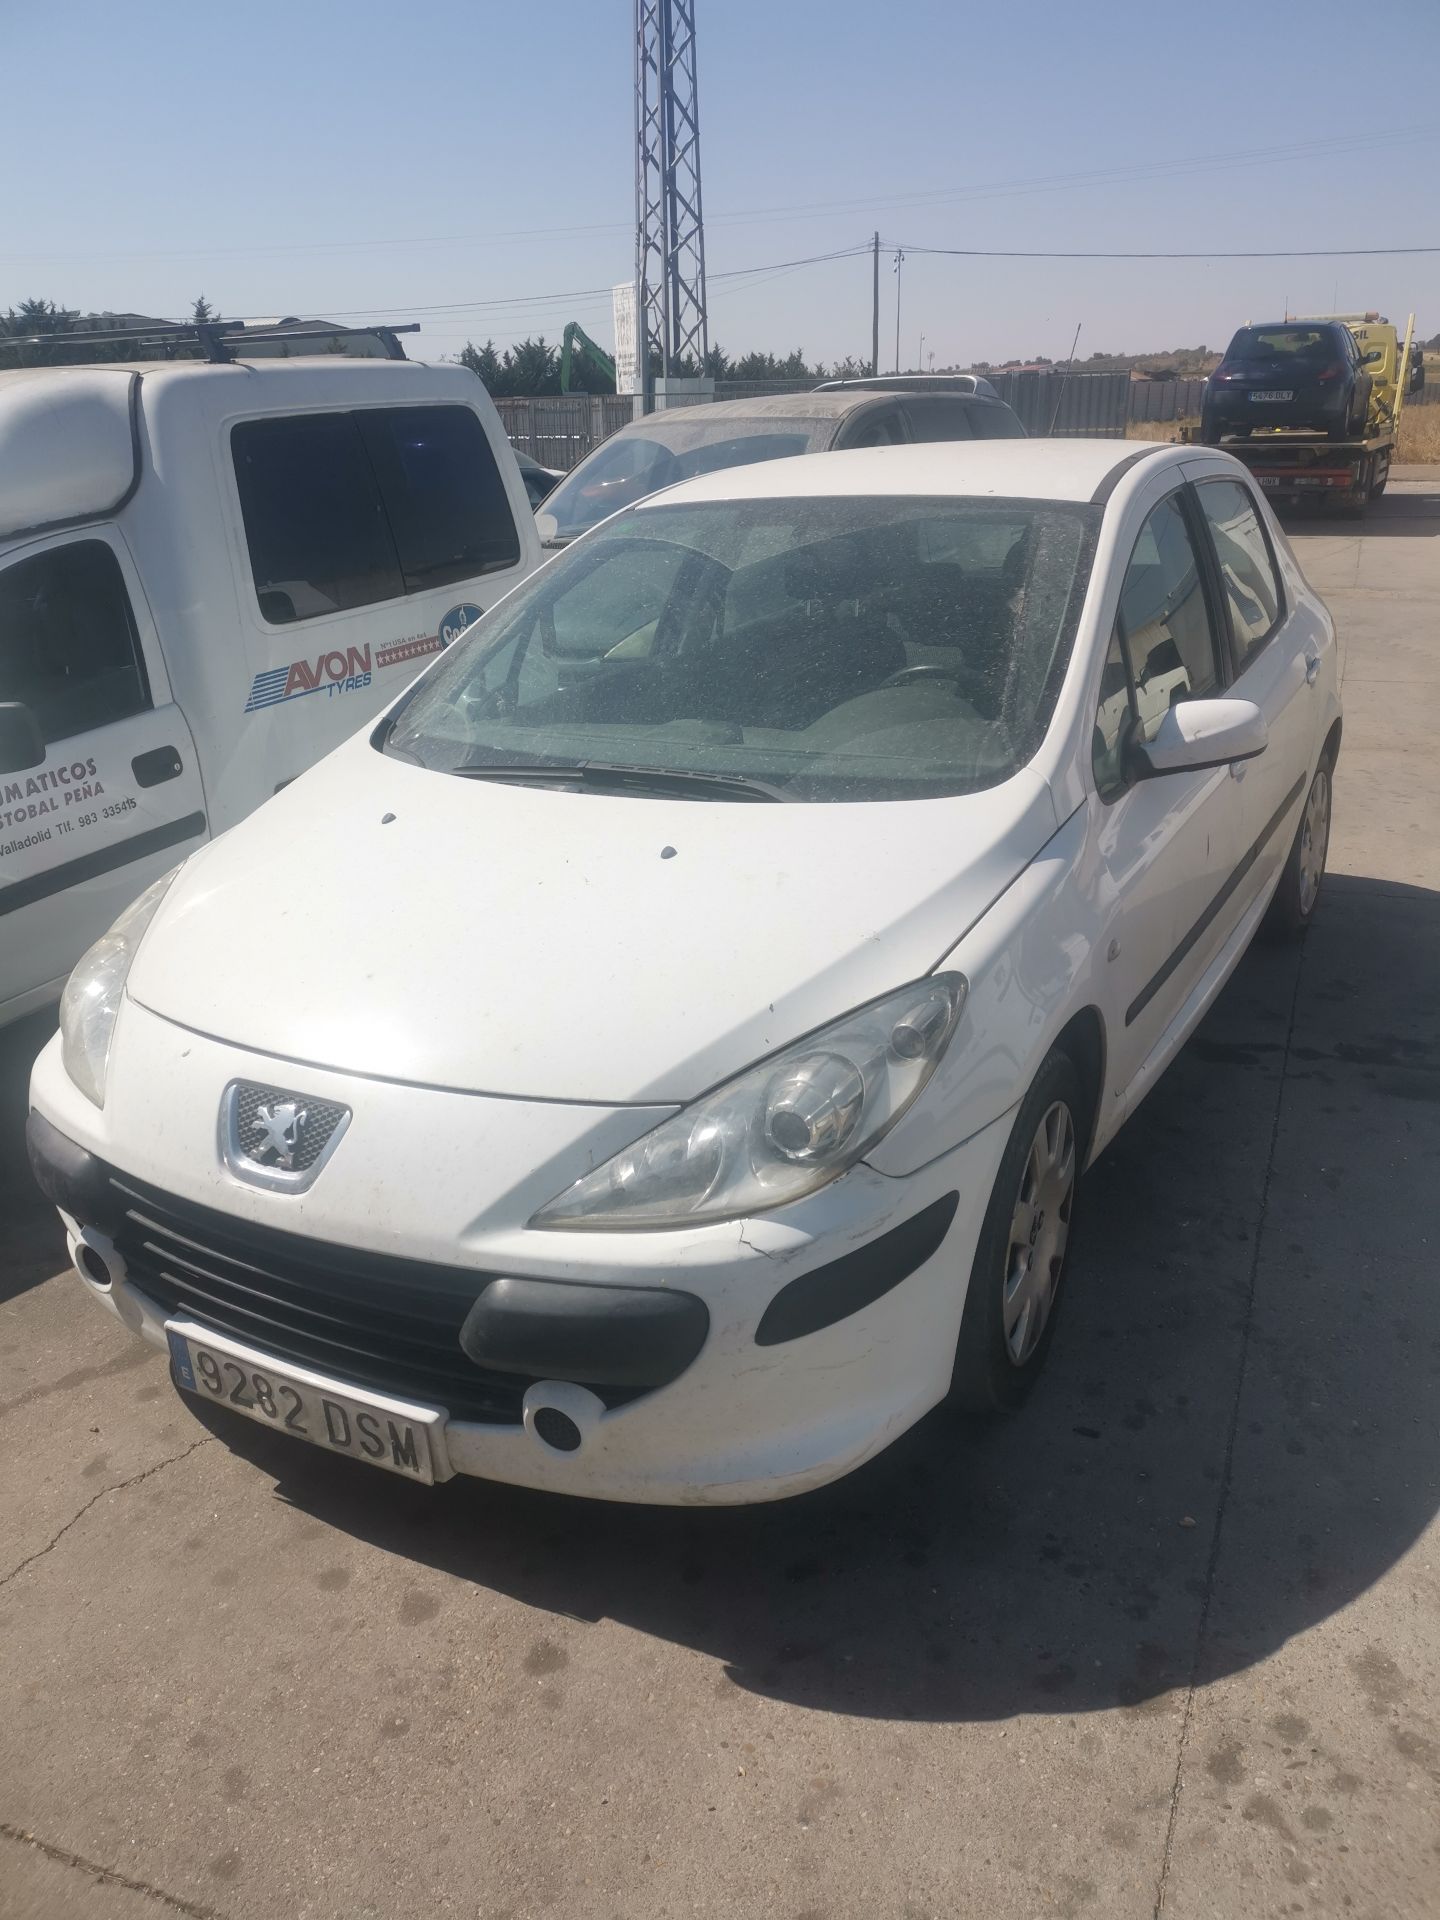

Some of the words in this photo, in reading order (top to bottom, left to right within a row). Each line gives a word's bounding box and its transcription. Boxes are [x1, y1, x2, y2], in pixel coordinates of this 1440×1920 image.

[392, 637, 406, 647] USA
[283, 642, 372, 697] AVON
[327, 671, 372, 698] TYRES
[64, 780, 105, 806] PEÑA
[78, 812, 98, 828] 983
[102, 797, 137, 819] 335415
[196, 1351, 308, 1434] 9282
[321, 1398, 420, 1474] DSM
